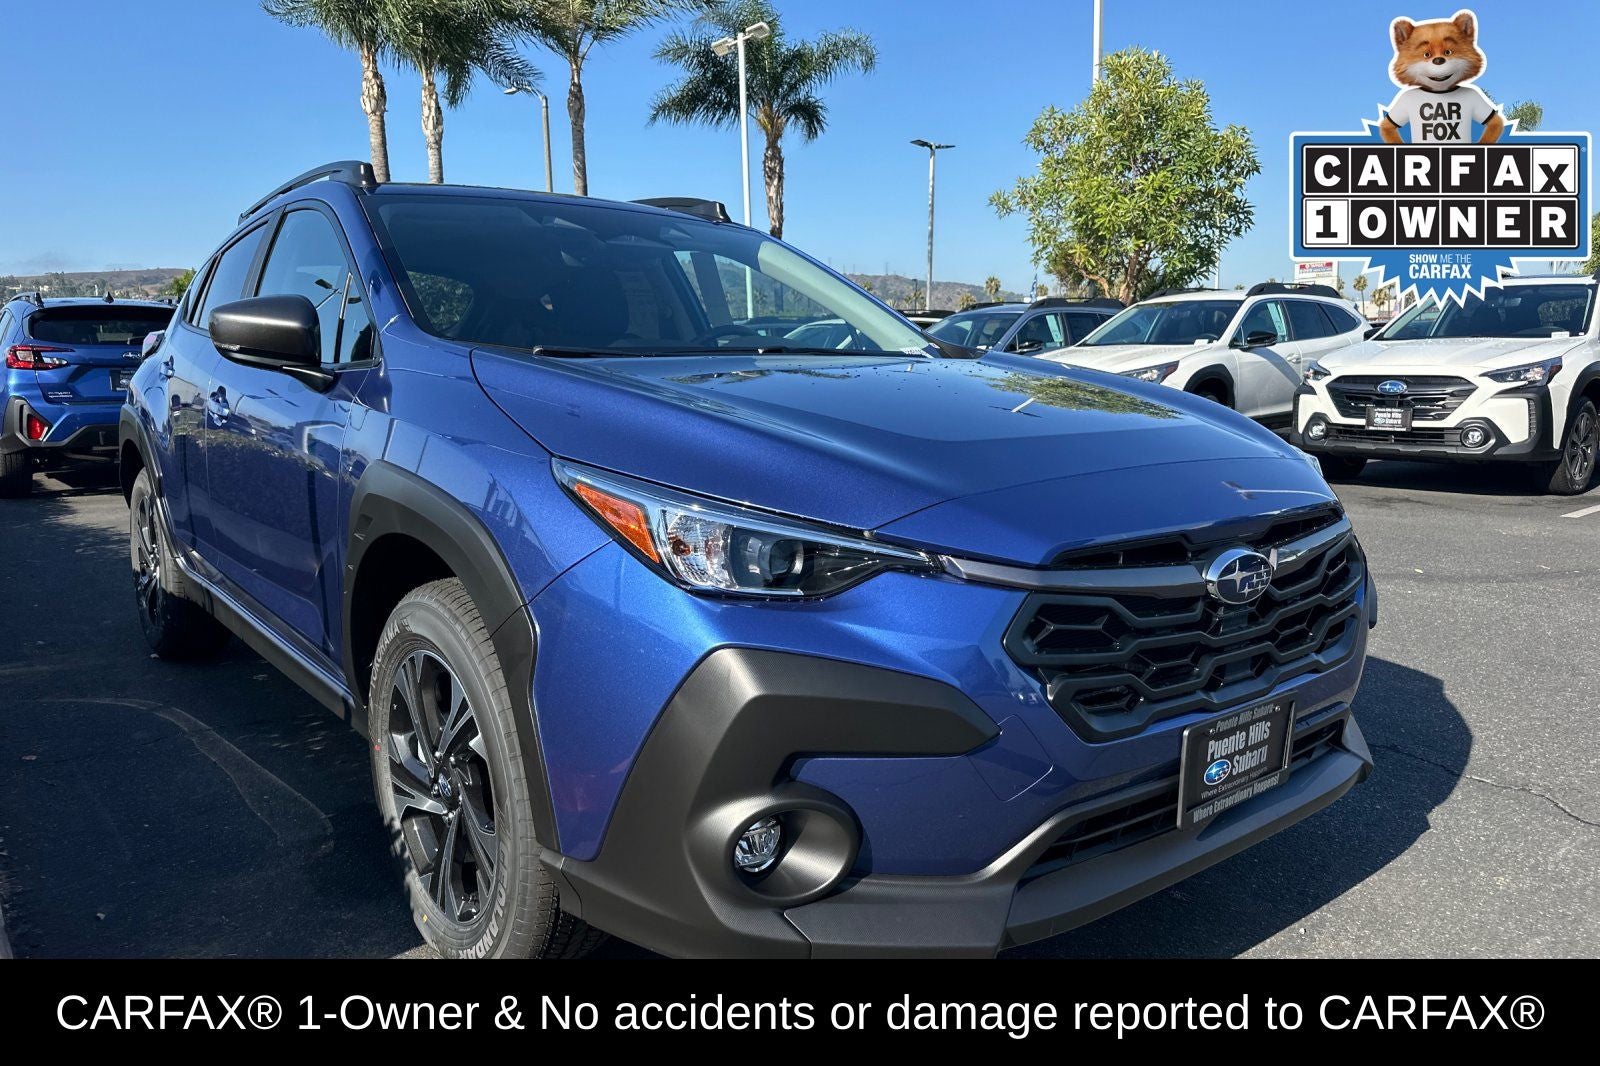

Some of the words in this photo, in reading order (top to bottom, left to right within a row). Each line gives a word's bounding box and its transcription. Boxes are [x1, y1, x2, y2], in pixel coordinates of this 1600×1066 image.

[371, 619, 401, 689] YOKOHAMA
[1206, 730, 1247, 763] Puente
[1248, 720, 1271, 747] Hills
[1232, 744, 1269, 776] Subaru
[1193, 804, 1213, 824] Where
[1213, 786, 1254, 814] Extraordinary
